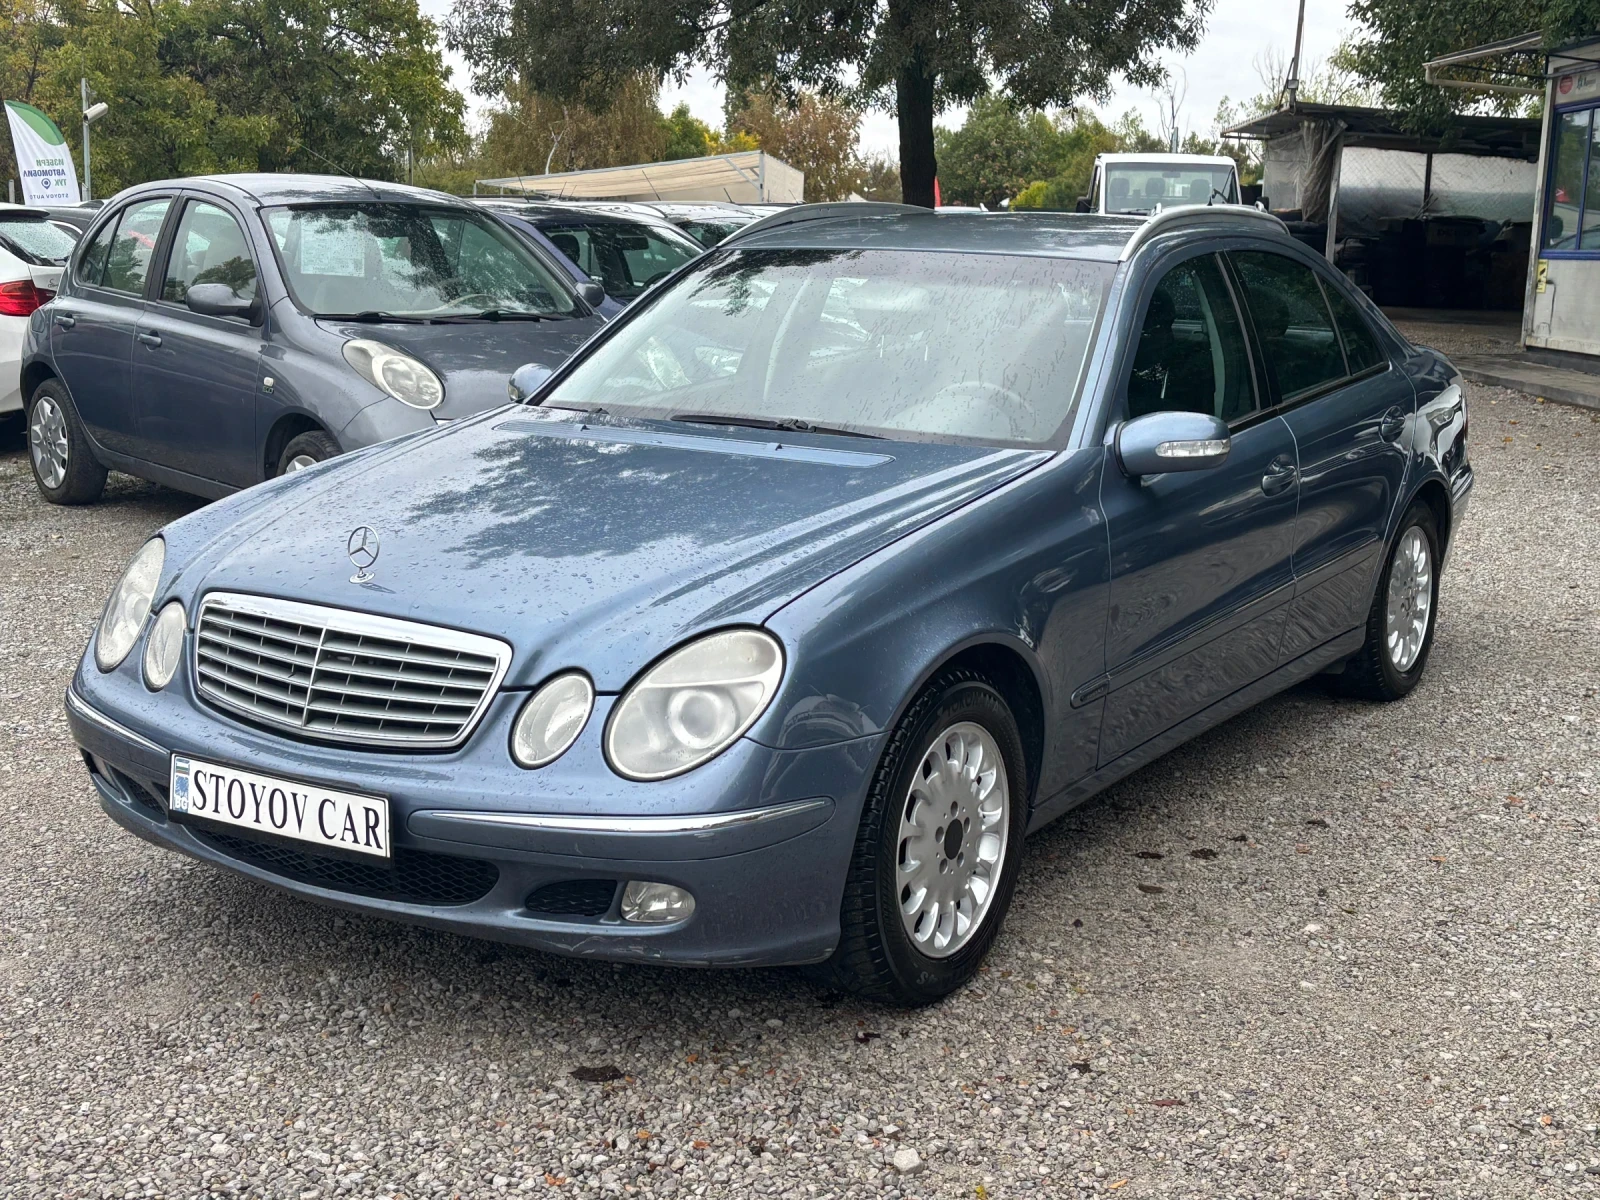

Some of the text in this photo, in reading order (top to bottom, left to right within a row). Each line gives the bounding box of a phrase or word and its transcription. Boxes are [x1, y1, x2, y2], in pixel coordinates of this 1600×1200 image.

[175, 796, 188, 810] BG
[193, 769, 383, 849] STOYOV CAR
